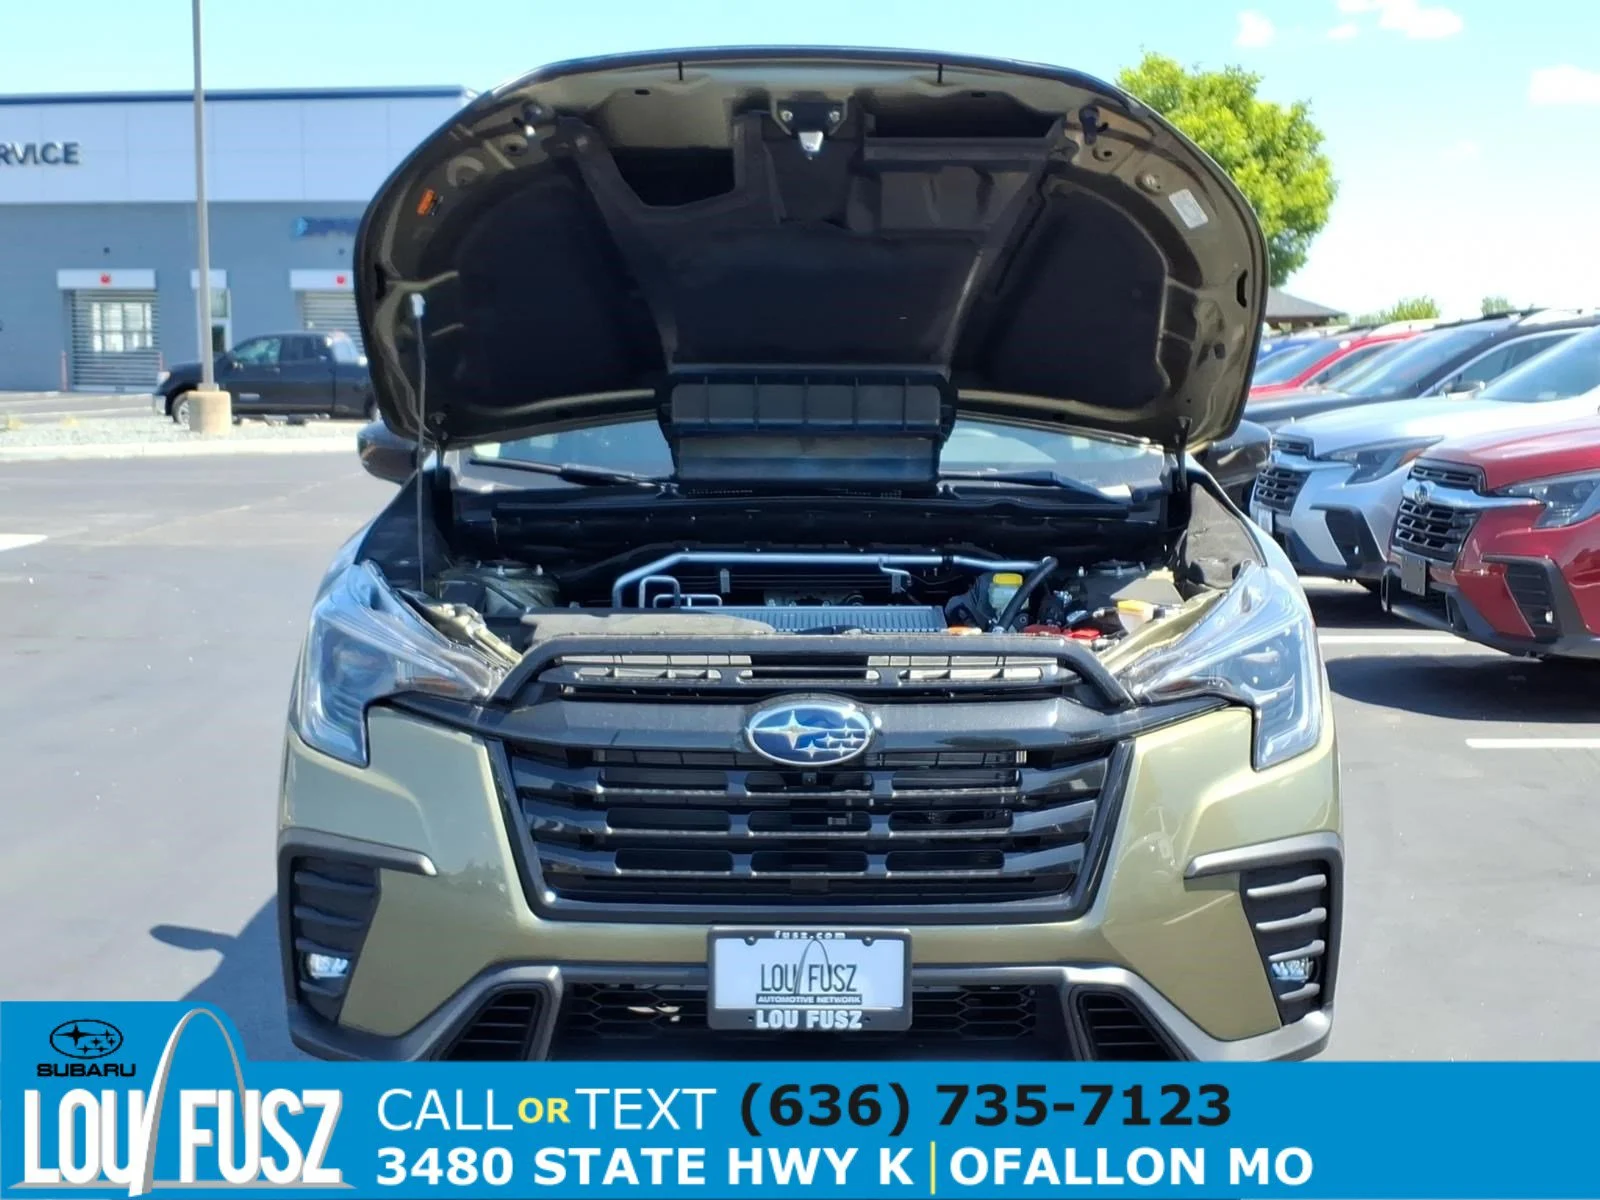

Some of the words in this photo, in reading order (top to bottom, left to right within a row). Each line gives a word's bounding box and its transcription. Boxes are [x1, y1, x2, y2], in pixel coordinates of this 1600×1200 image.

[775, 930, 846, 940] fusz.com
[761, 964, 796, 992] LOU
[808, 964, 857, 992] FUSZ
[758, 996, 814, 1004] AUTOMOTIVE
[816, 996, 861, 1004] NETWORK
[756, 1010, 799, 1029] LOU
[806, 1010, 862, 1029] FUSZ
